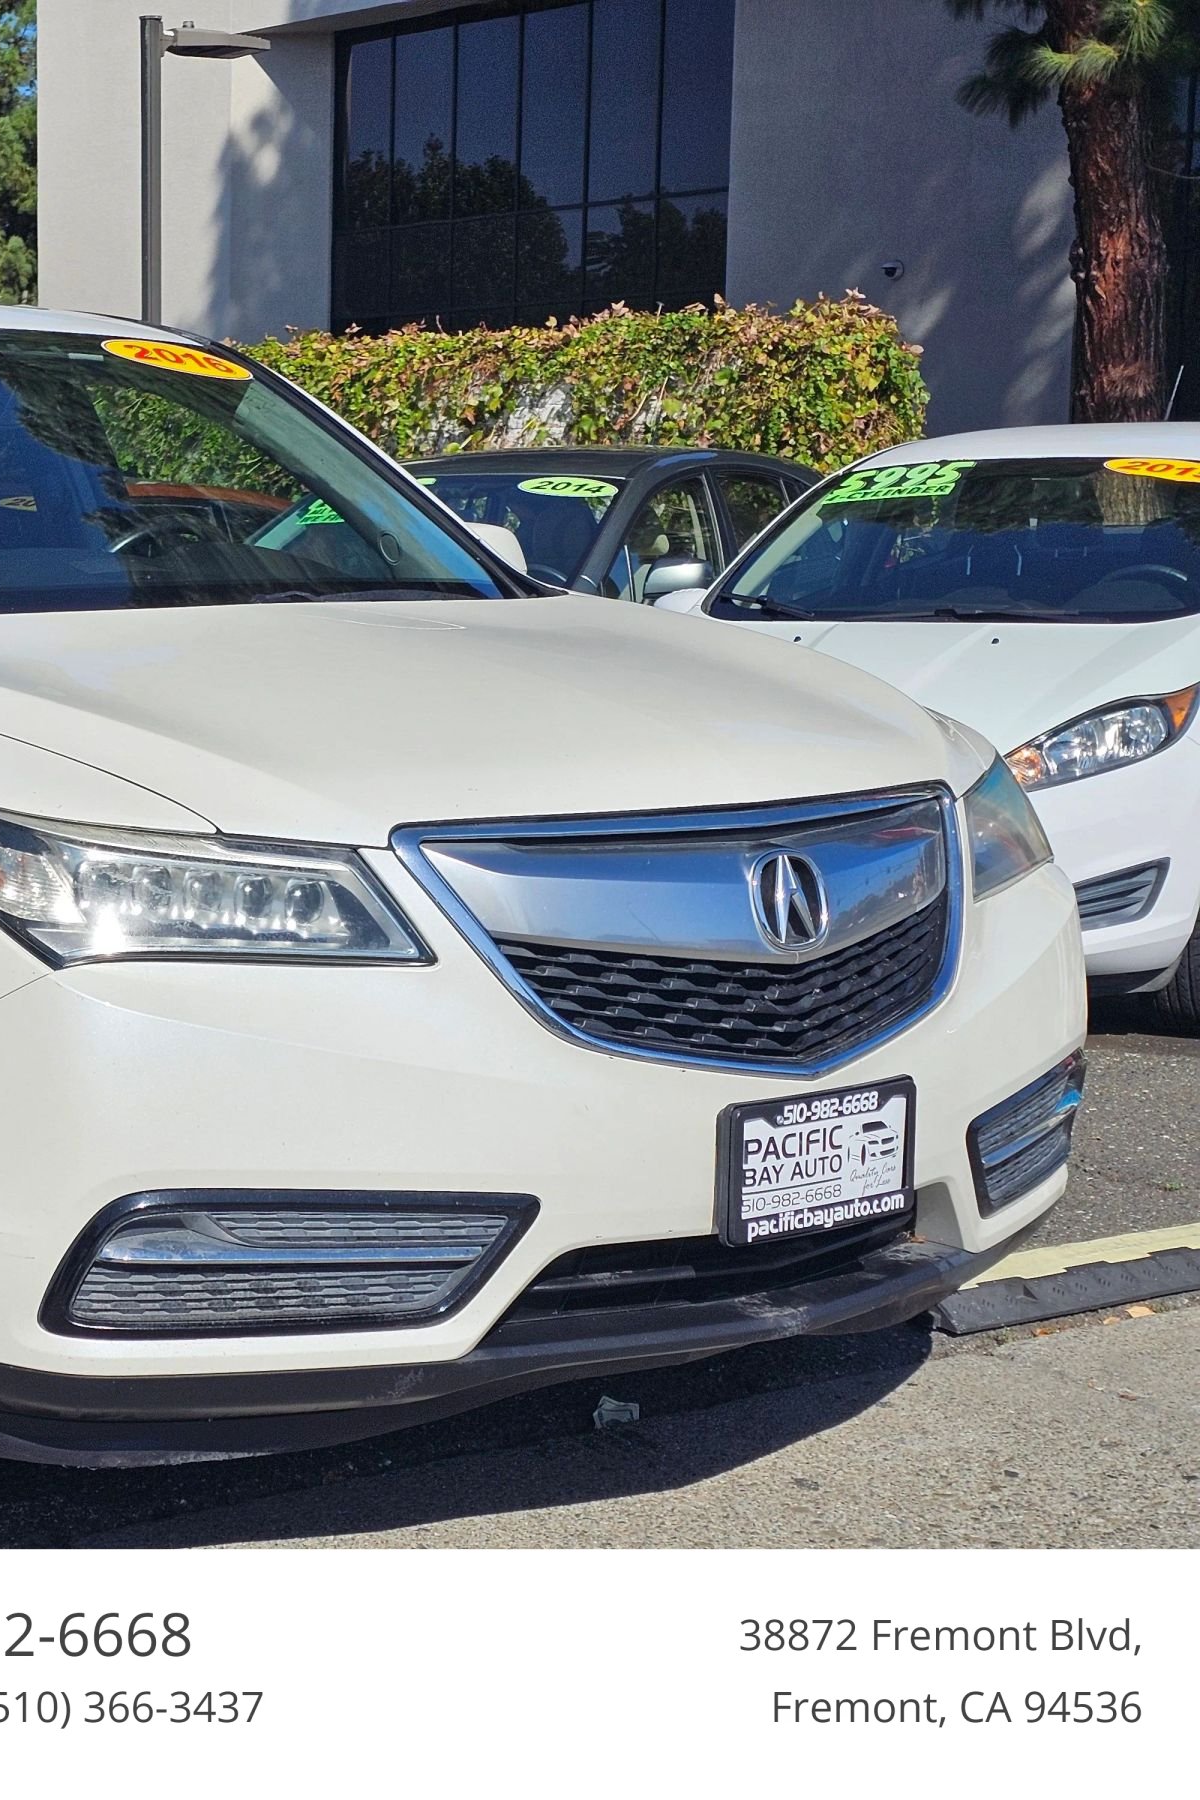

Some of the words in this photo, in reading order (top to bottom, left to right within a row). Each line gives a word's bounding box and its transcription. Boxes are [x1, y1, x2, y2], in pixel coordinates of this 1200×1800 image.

[123, 344, 238, 374] 2016
[533, 479, 604, 495] 2014
[832, 461, 977, 495] 5995
[783, 1091, 879, 1126] 510-982-6668
[744, 1124, 843, 1165] PACIFIC
[744, 1164, 784, 1187] BAY
[791, 1154, 843, 1182] AUTO
[743, 1183, 843, 1213] 510-982-6668
[747, 1193, 905, 1243] pacificbayauto.com
